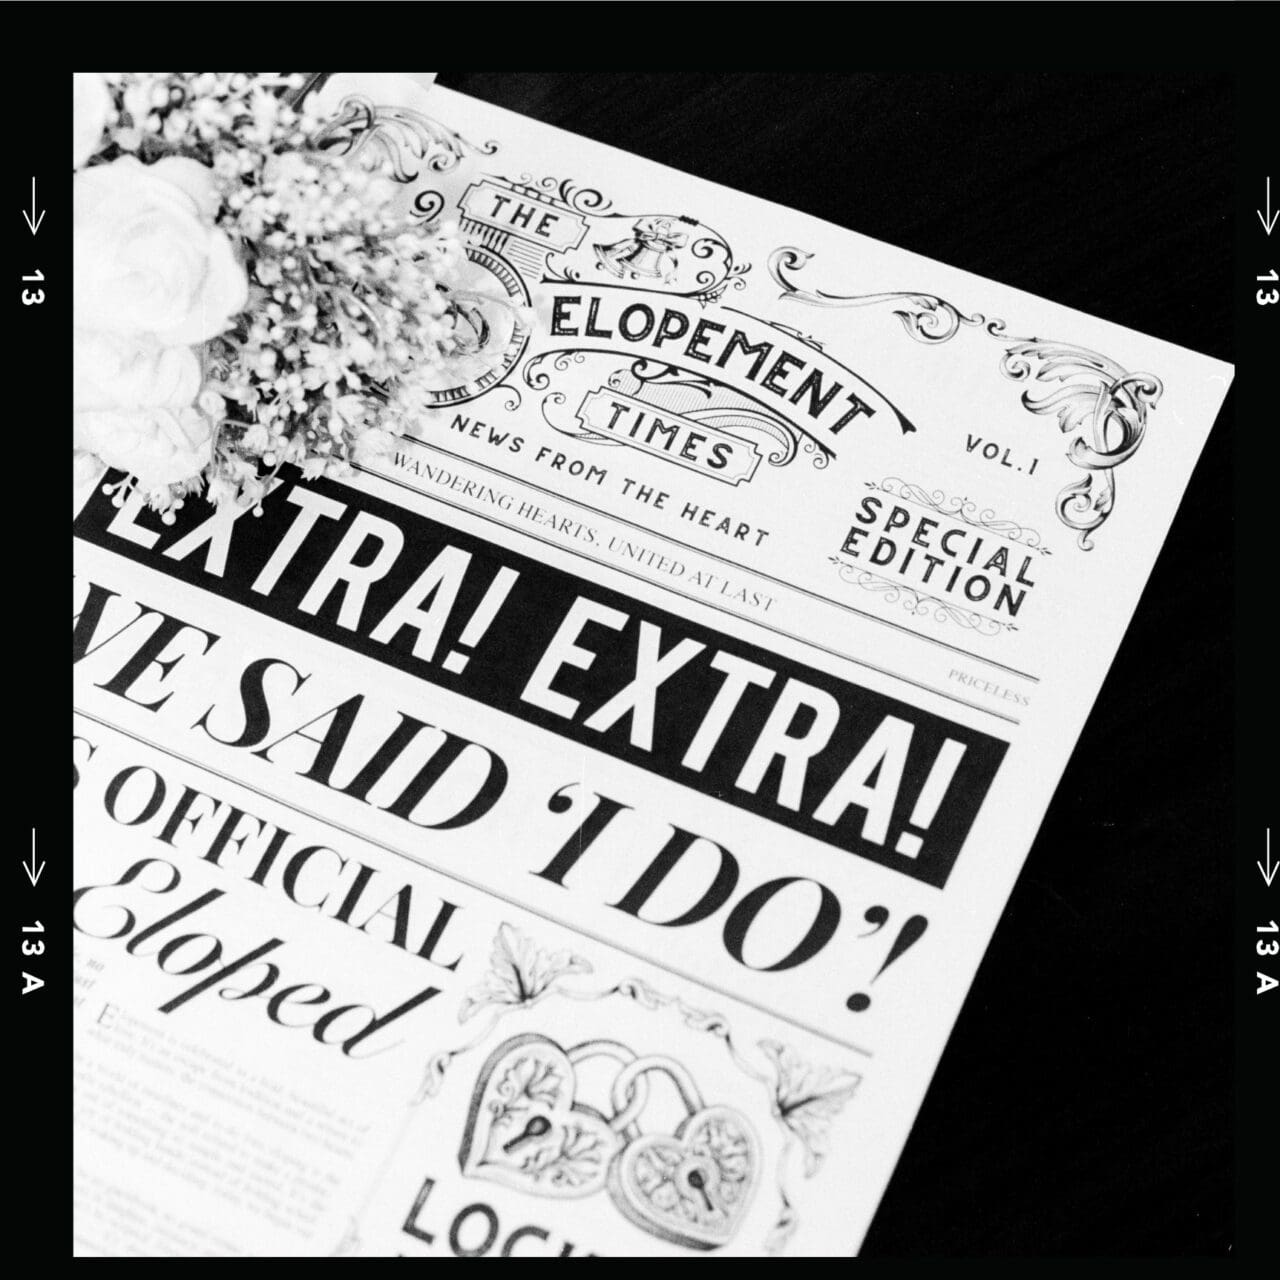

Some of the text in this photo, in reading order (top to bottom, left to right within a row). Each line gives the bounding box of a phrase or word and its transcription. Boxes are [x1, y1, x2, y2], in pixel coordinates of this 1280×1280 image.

[490, 194, 561, 238] THE
[550, 295, 877, 436] ELOPEMENT
[450, 413, 770, 547] NEWS FROM THE HEART
[607, 402, 734, 471] TIMES
[393, 451, 779, 613] WANDERING HEARTS, UNITED AT LAST
[840, 525, 1027, 617] EDITION
[855, 496, 1036, 588] SPECIAL
[190, 657, 509, 831] SAID
[519, 595, 967, 860] EXTRA!
[949, 668, 1031, 708] PRICELESS
[104, 764, 465, 973] OFFICIAL
[73, 857, 443, 1060] Eloped
